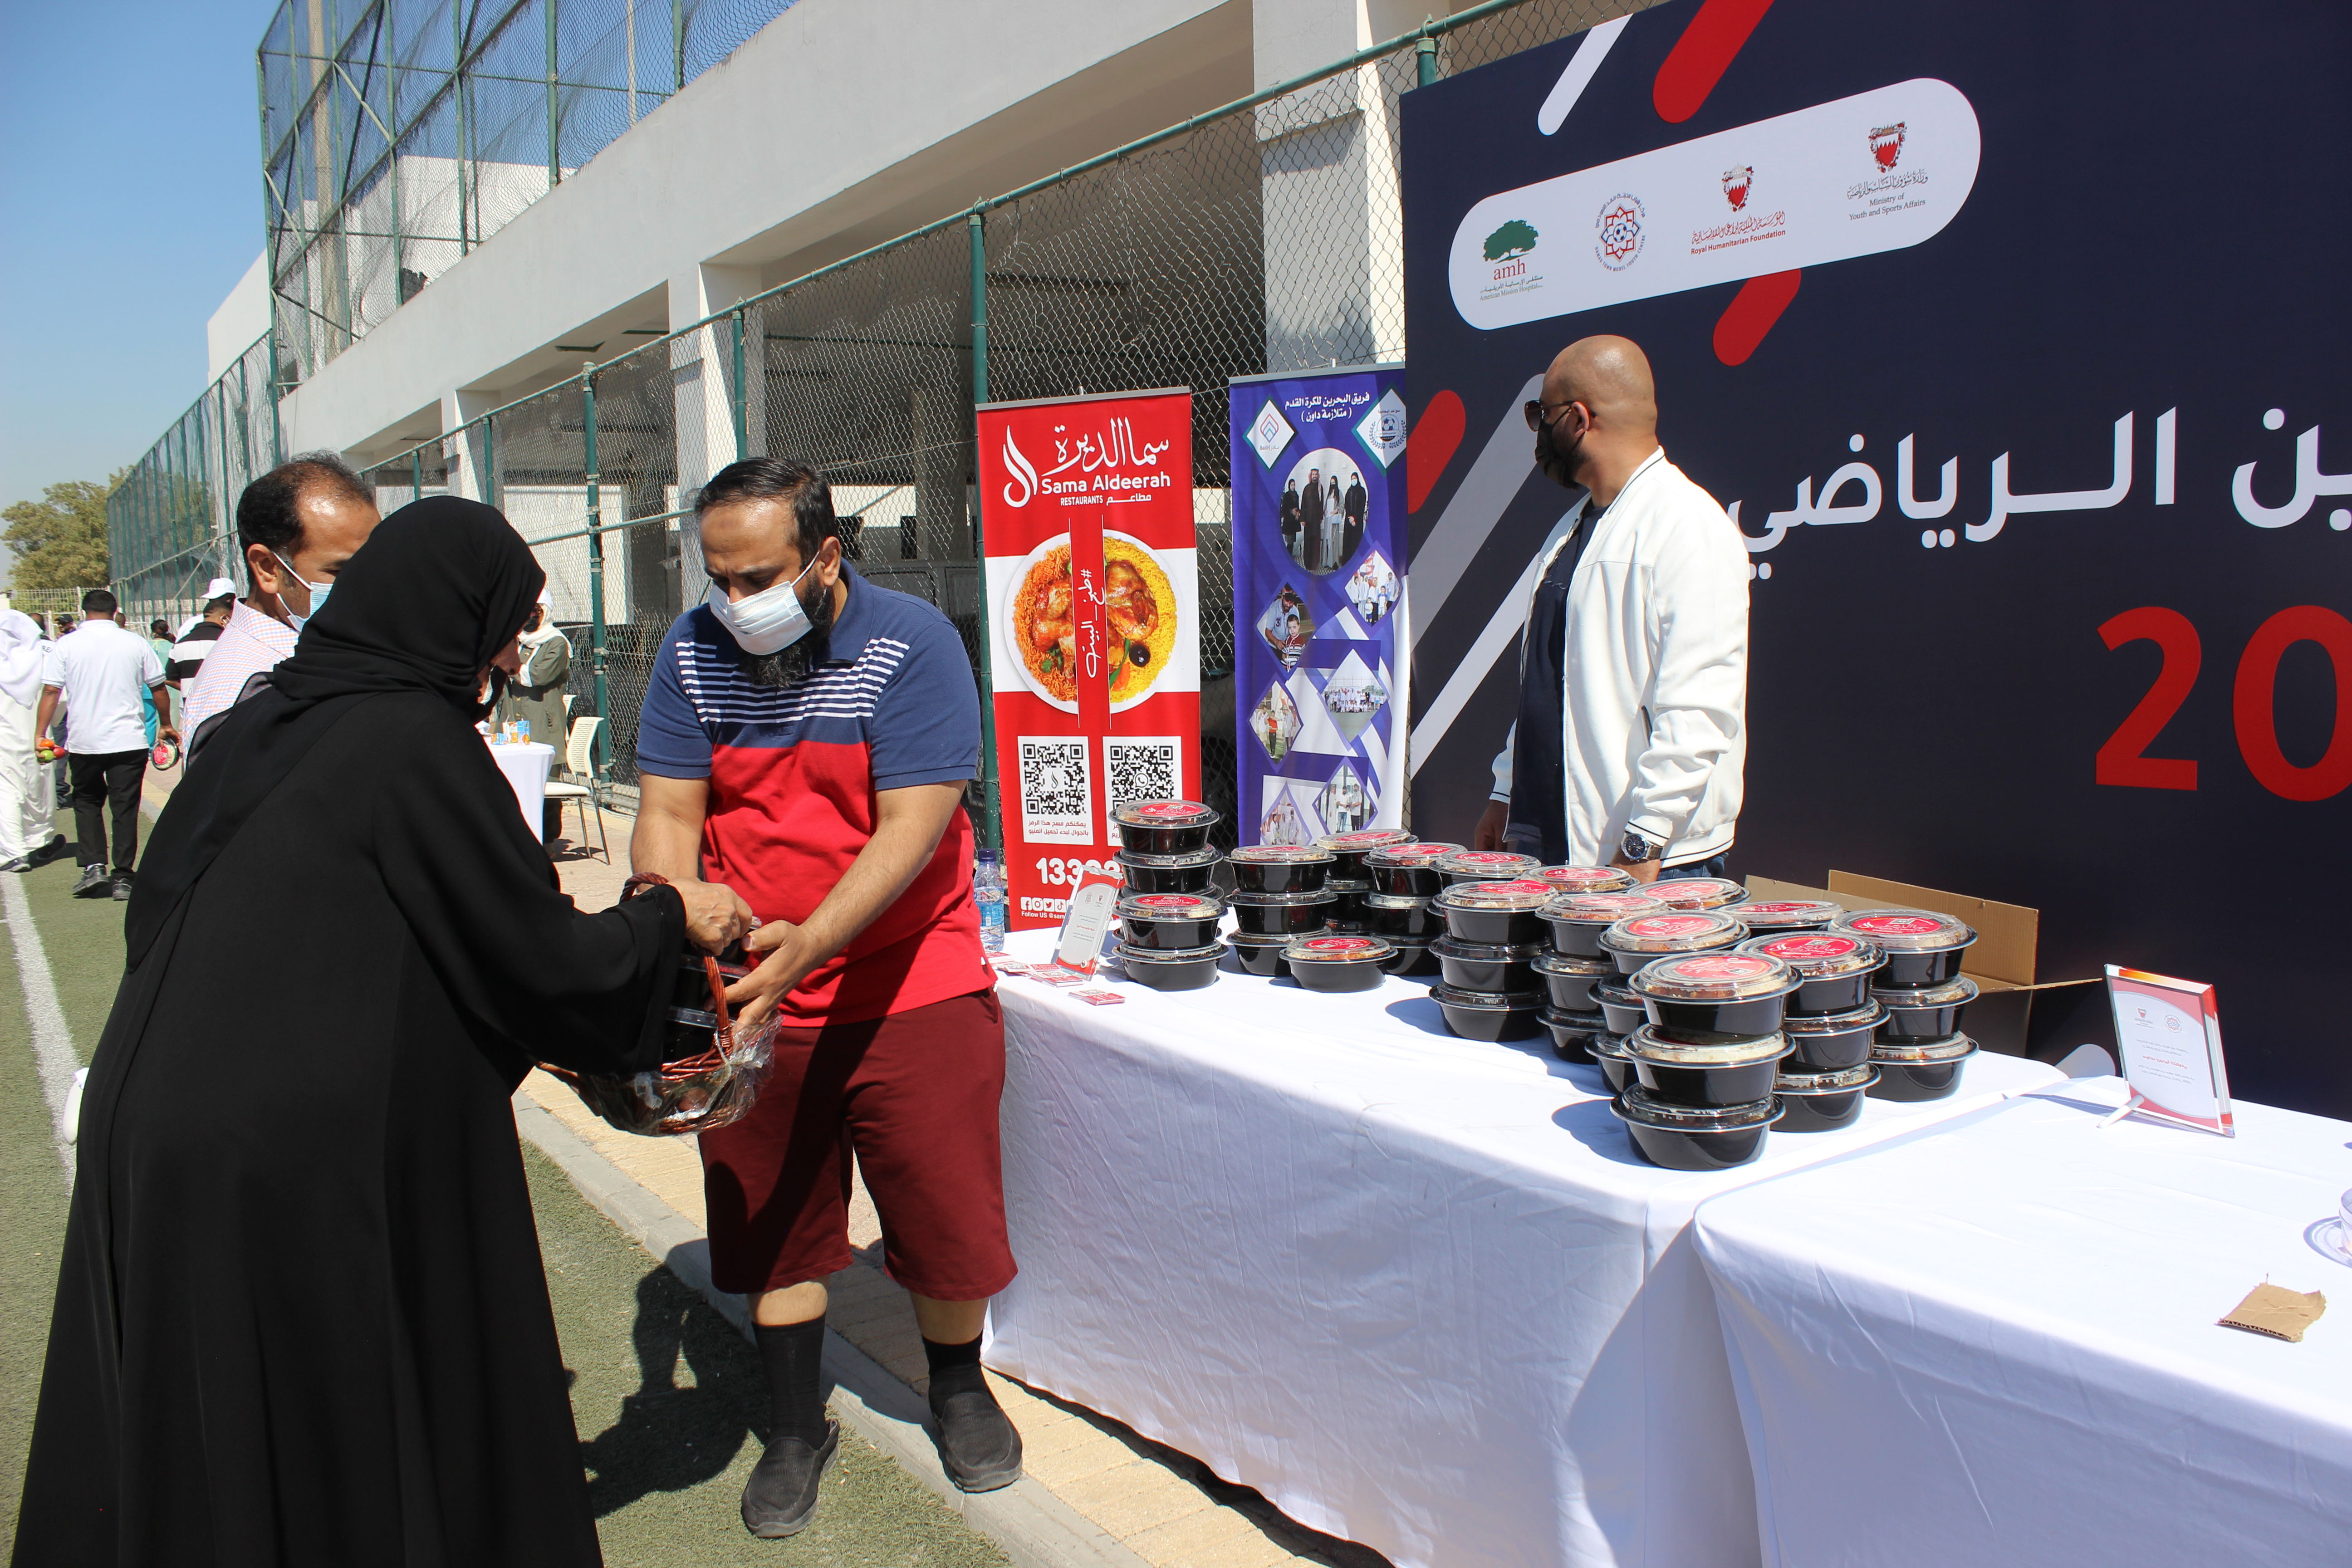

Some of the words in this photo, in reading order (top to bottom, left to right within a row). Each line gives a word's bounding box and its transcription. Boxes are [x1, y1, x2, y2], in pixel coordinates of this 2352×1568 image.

[1869, 195, 1896, 206] Ministry
[1897, 192, 1905, 201] of
[1849, 211, 1867, 220] Youth
[1868, 207, 1880, 216] and
[1882, 204, 1902, 215] Sports
[1903, 199, 1926, 209] Affairs
[1691, 245, 1707, 255] Royal
[1708, 237, 1749, 251] Humanitarian
[1750, 229, 1786, 242] Foundation
[1602, 261, 1612, 271] TOWN
[1627, 255, 1638, 268] YOUTH
[1637, 235, 1646, 254] CENTRE
[1493, 258, 1526, 280] amh
[1480, 292, 1500, 302] American
[1501, 288, 1518, 297] Mission
[1519, 283, 1538, 293] Hospital
[1285, 398, 1304, 411] القدم
[1305, 396, 1322, 409] للكرة
[1323, 394, 1351, 408] البحرين
[1351, 392, 1370, 405] فريق
[1306, 412, 1321, 423] داون
[1322, 408, 1347, 421] متلازمة
[1041, 416, 1126, 477] الديرة
[1124, 416, 1169, 466] سما
[1042, 478, 1088, 495] Sama
[1092, 471, 1171, 491] Aldeerah
[1060, 495, 1103, 506] RESTAURANTS
[1727, 406, 2176, 580] الرياضي
